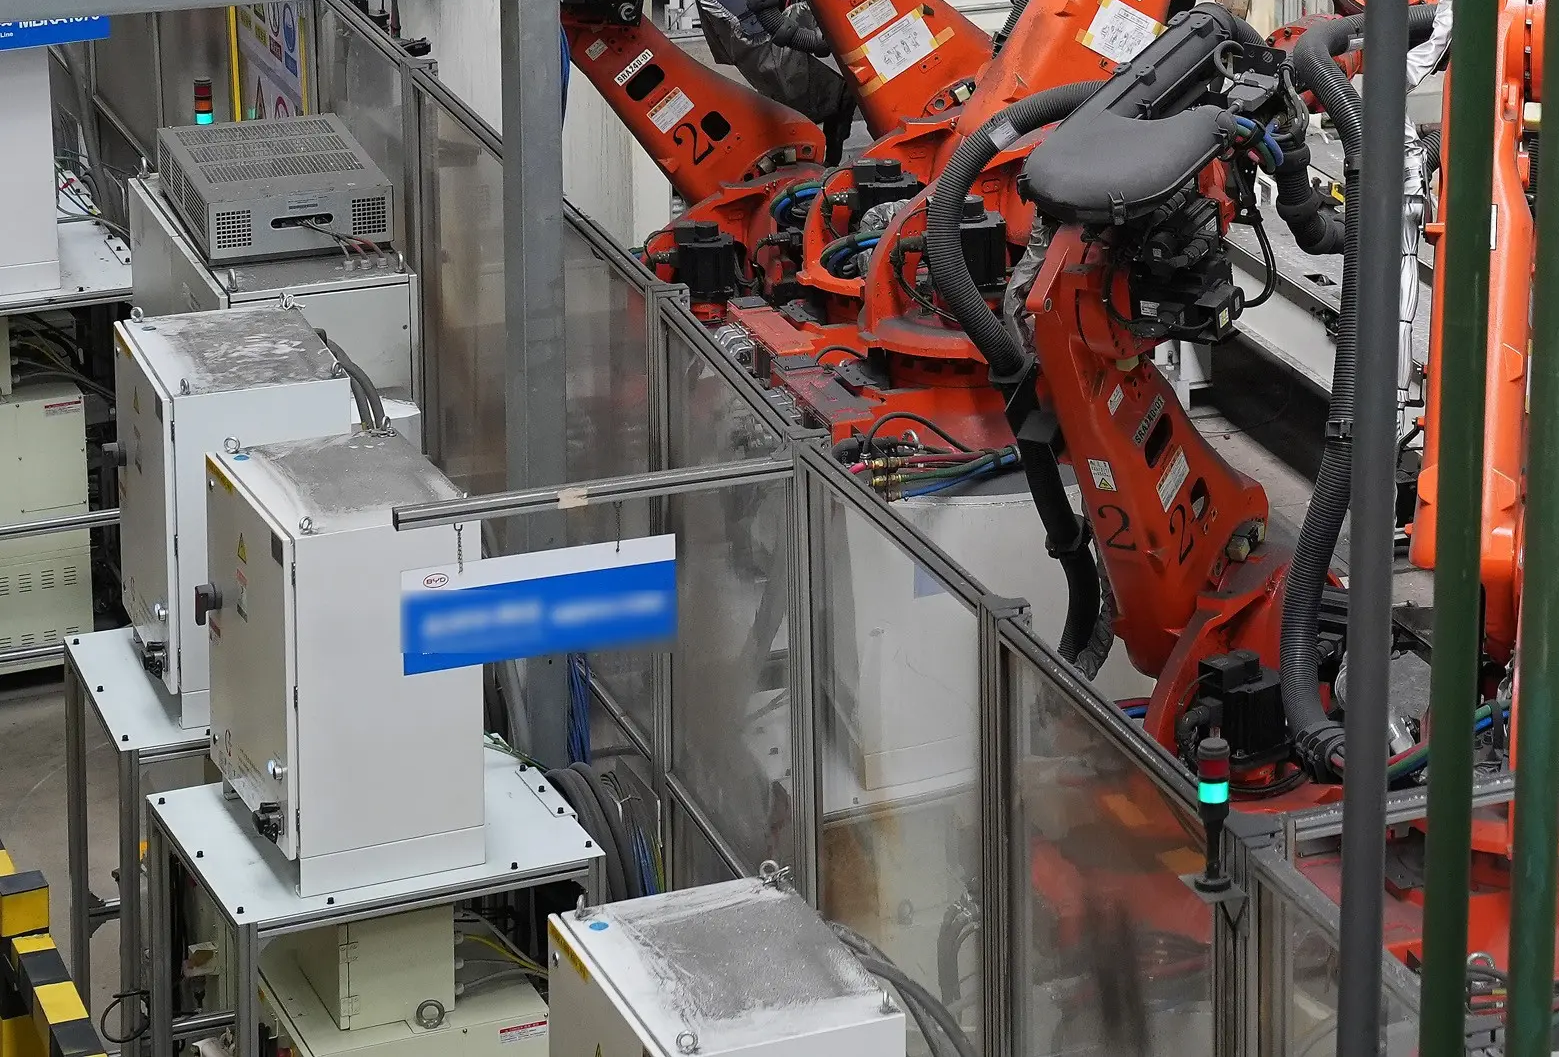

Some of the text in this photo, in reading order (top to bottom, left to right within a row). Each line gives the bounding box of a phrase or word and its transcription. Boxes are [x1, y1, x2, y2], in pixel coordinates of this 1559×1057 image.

[616, 50, 652, 84] SRA240-01
[673, 122, 715, 166] 2
[1134, 395, 1164, 444] SRA240-01
[1097, 504, 1137, 551] 2
[1169, 503, 1194, 565] 2
